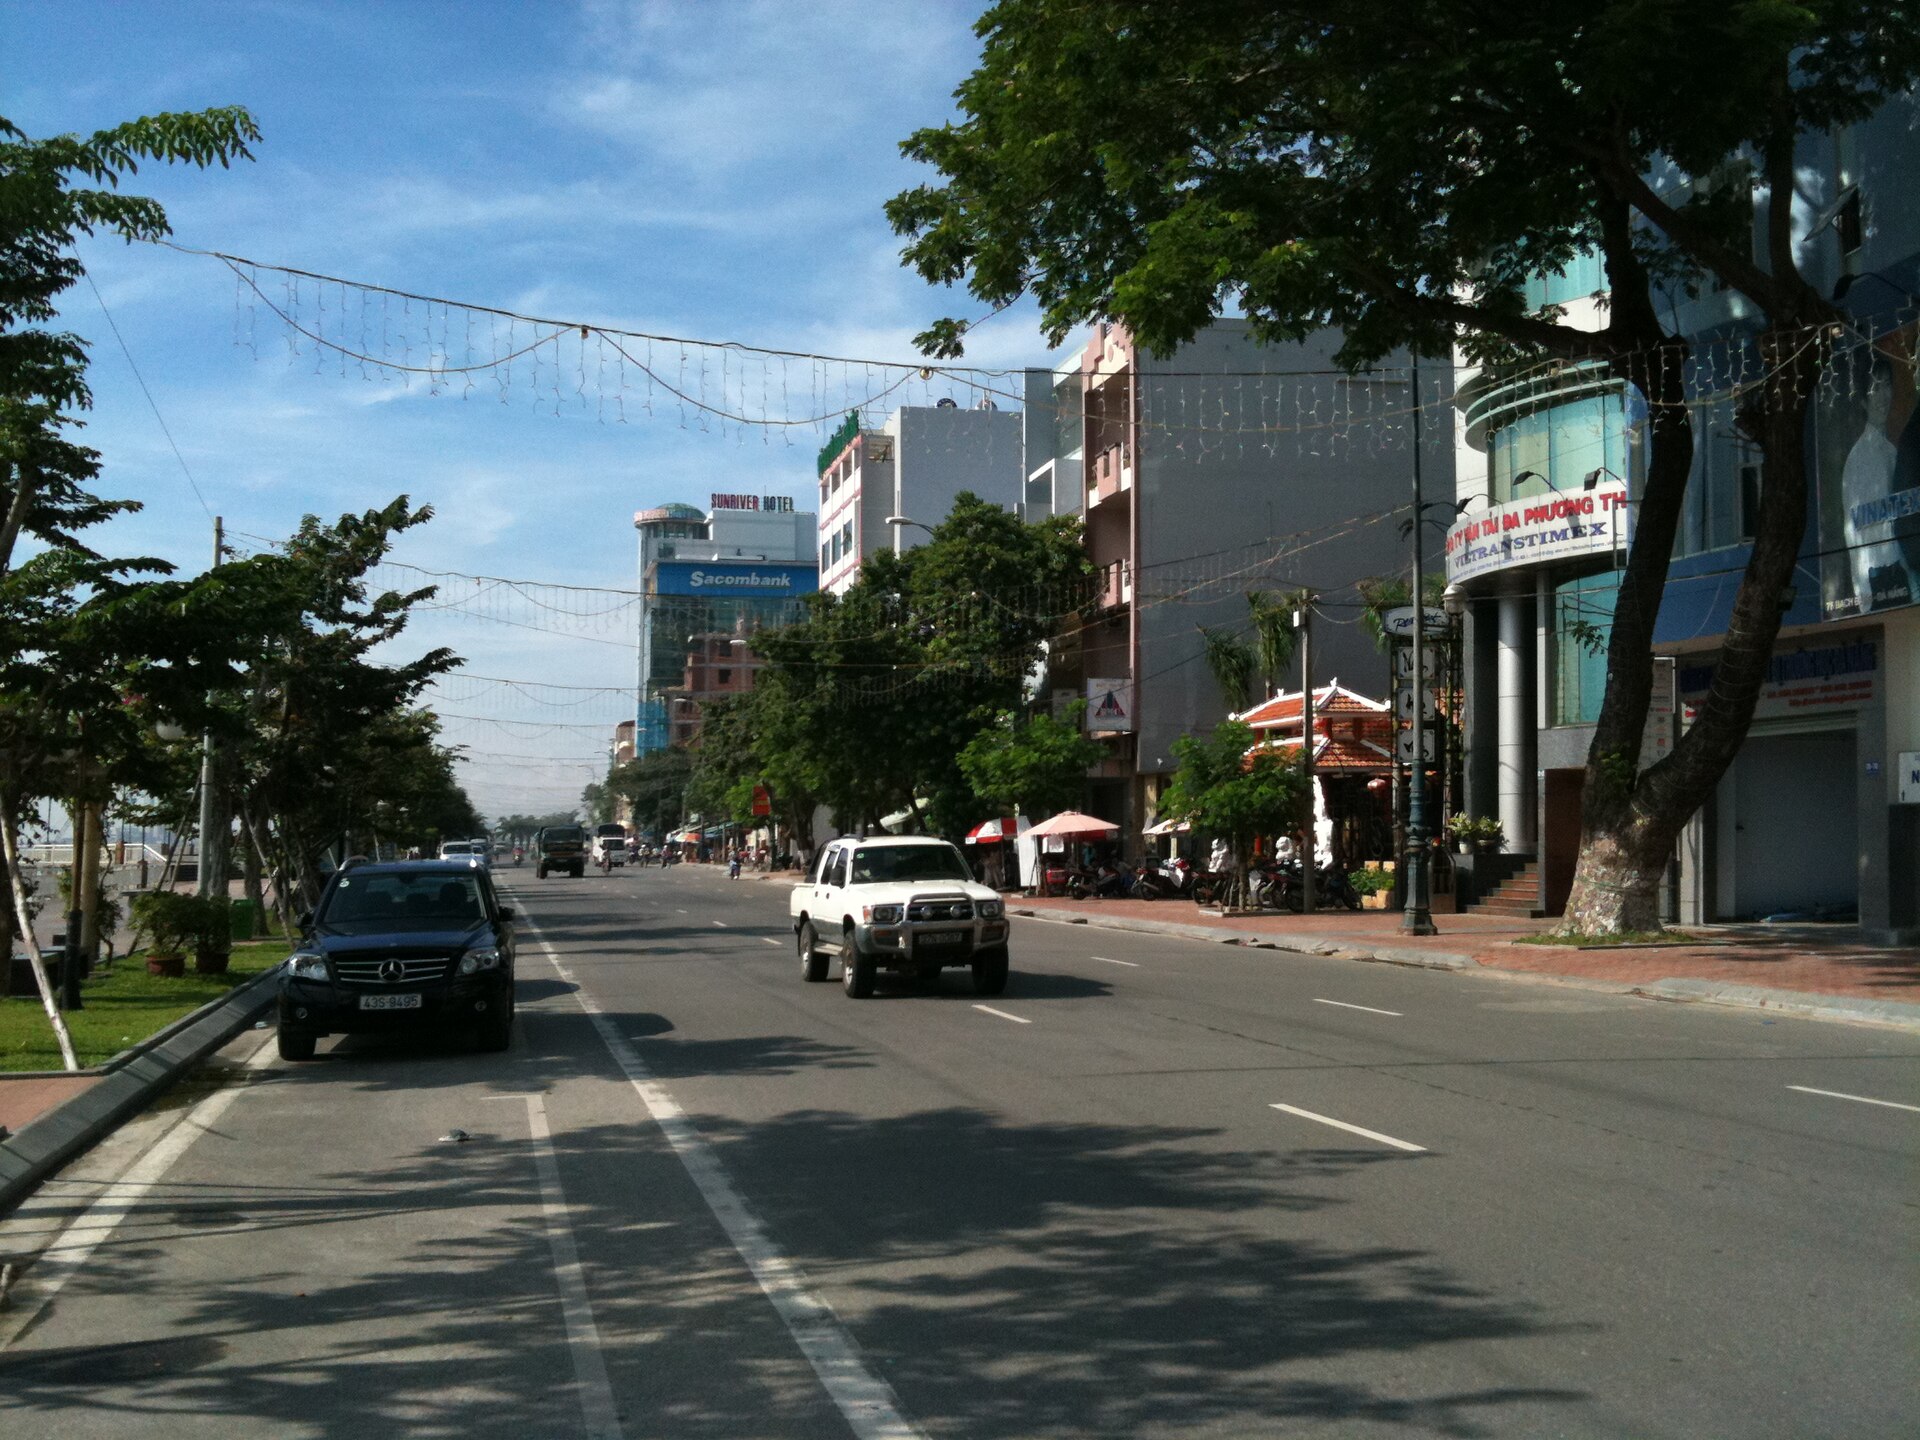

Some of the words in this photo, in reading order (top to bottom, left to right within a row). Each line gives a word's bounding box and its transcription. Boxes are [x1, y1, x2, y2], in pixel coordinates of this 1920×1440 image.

[711, 493, 759, 511] SUNRIVER
[763, 496, 794, 511] HOTEL
[1524, 496, 1594, 526] PHƯƠNG
[1454, 521, 1608, 568] VIETRANSTIMEX
[690, 570, 791, 588] Sacombank
